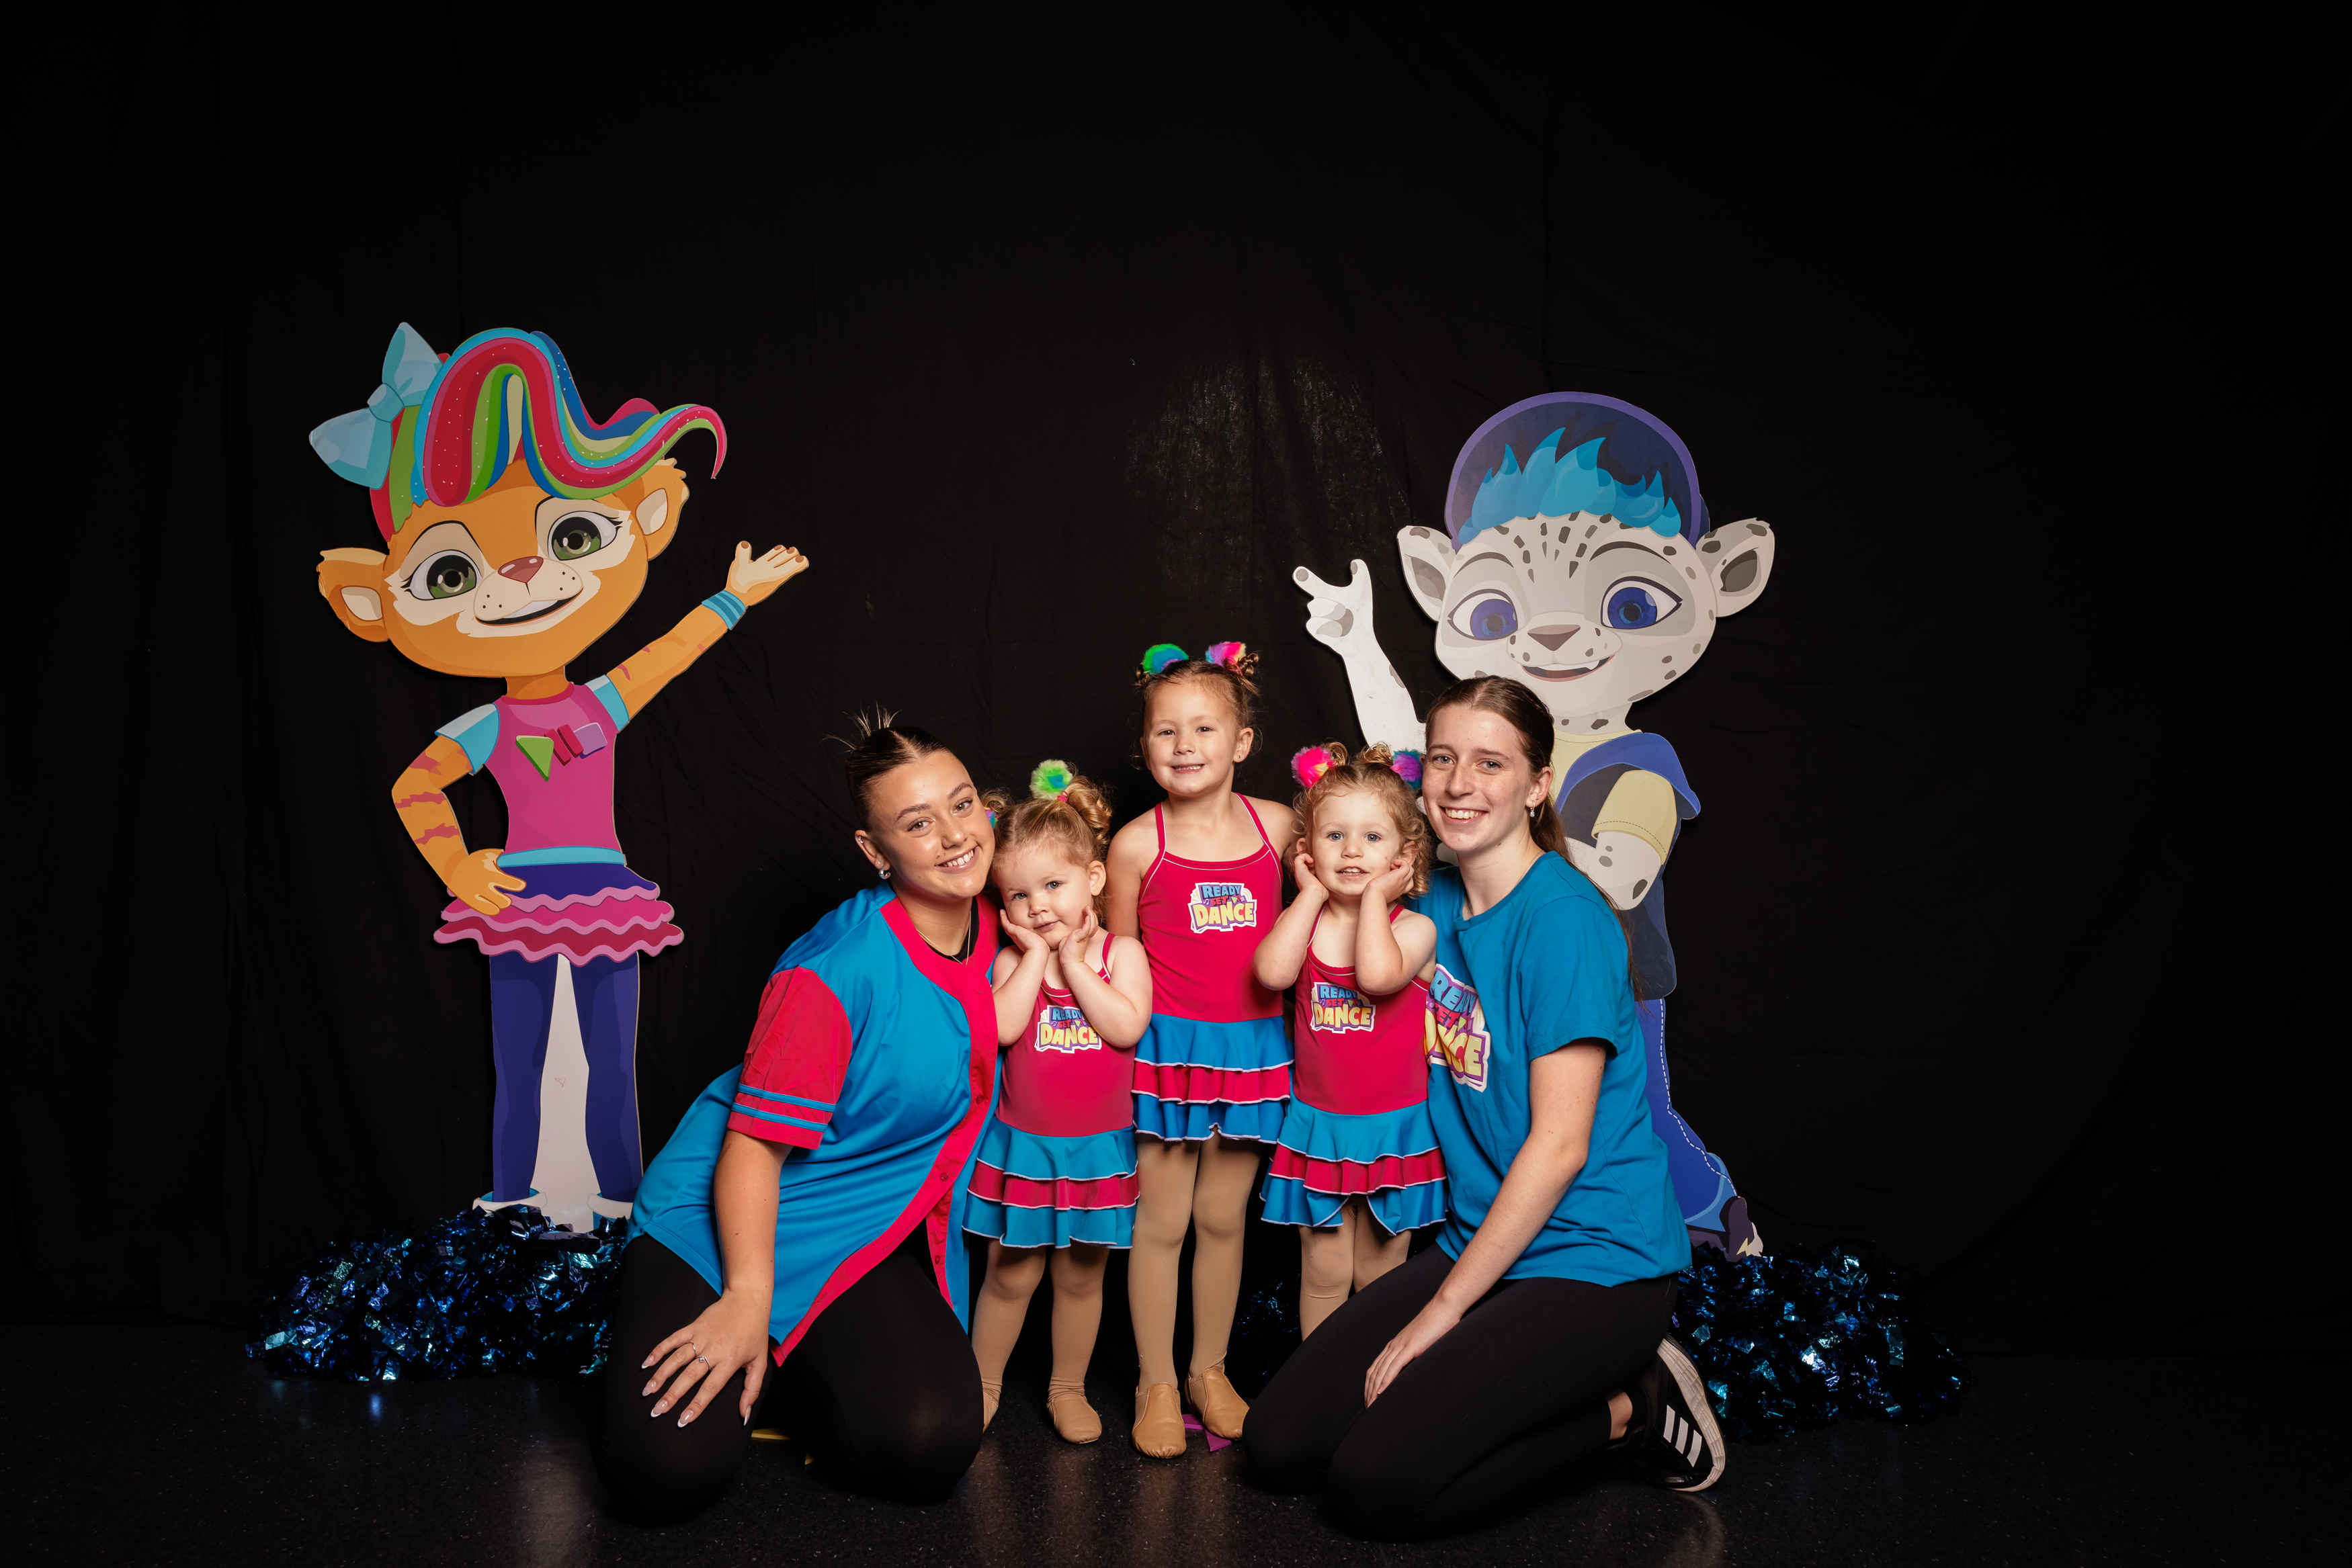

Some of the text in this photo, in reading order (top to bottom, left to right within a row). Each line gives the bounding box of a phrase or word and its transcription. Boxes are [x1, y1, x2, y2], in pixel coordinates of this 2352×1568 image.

[1202, 885, 1241, 898] READY
[1211, 896, 1228, 905] SET
[1192, 901, 1254, 927] DANCE
[1320, 986, 1356, 998] READY
[1430, 970, 1476, 1013] READY
[1327, 998, 1345, 1007] SET
[1052, 1008, 1082, 1020] READY
[1313, 1003, 1372, 1028] DANCE
[1434, 1002, 1461, 1028] ET
[1058, 1019, 1072, 1028] SET
[1040, 1023, 1098, 1048] DANCE
